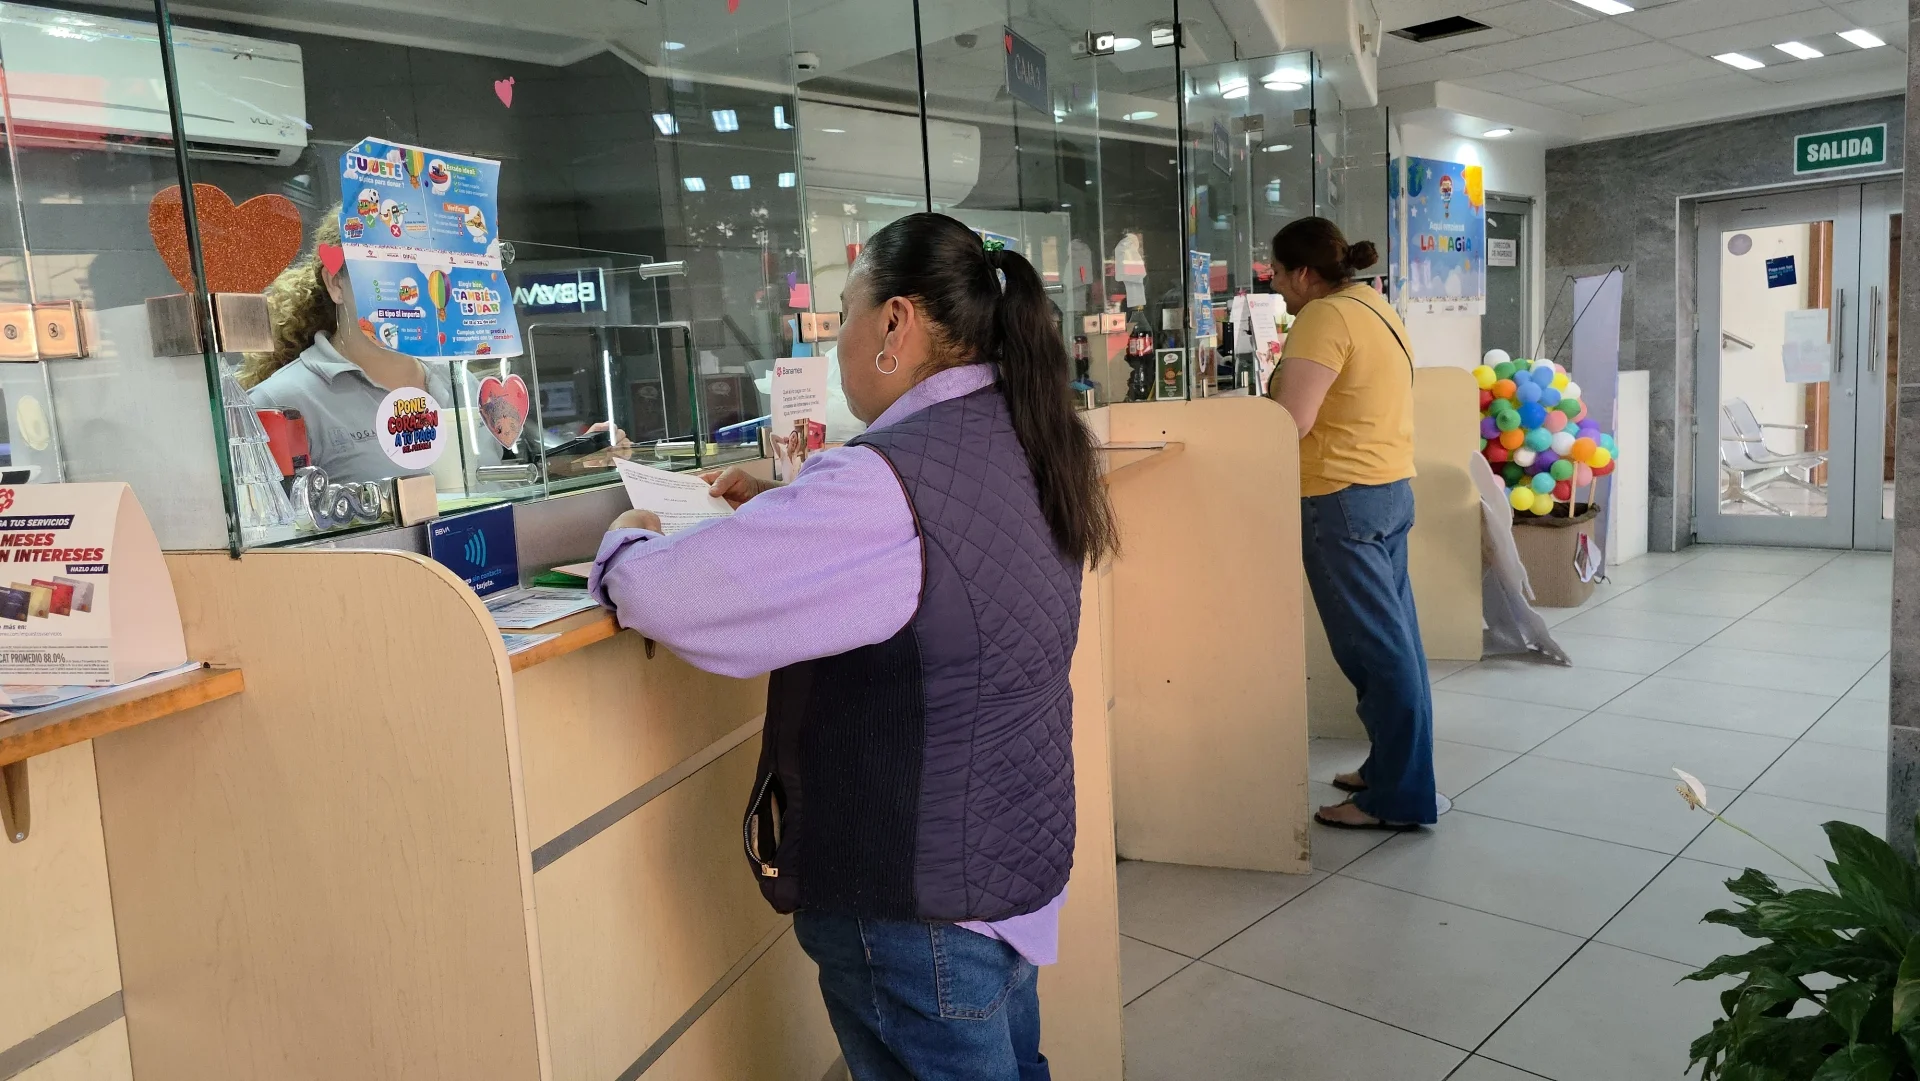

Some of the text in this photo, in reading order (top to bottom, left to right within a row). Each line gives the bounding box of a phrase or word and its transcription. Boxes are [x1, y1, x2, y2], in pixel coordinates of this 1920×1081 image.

[1807, 136, 1873, 162] SALIDA
[1421, 234, 1435, 251] LA
[385, 310, 396, 319] tipo
[402, 311, 420, 319] importa
[461, 303, 499, 314] ES DAR
[387, 408, 439, 435] CORAZÓN
[394, 427, 437, 447] A TU PAGO
[10, 519, 27, 527] TUS
[27, 518, 70, 527] SERVICIOS
[434, 526, 451, 537] BBVA
[1, 533, 56, 547] MESES
[14, 548, 105, 563] INTERESES
[90, 565, 105, 573] AQUÍ
[472, 574, 481, 582] sin
[481, 568, 502, 580] contacto
[476, 579, 495, 590] tarjeta.
[11, 652, 42, 664] PROMEDIO
